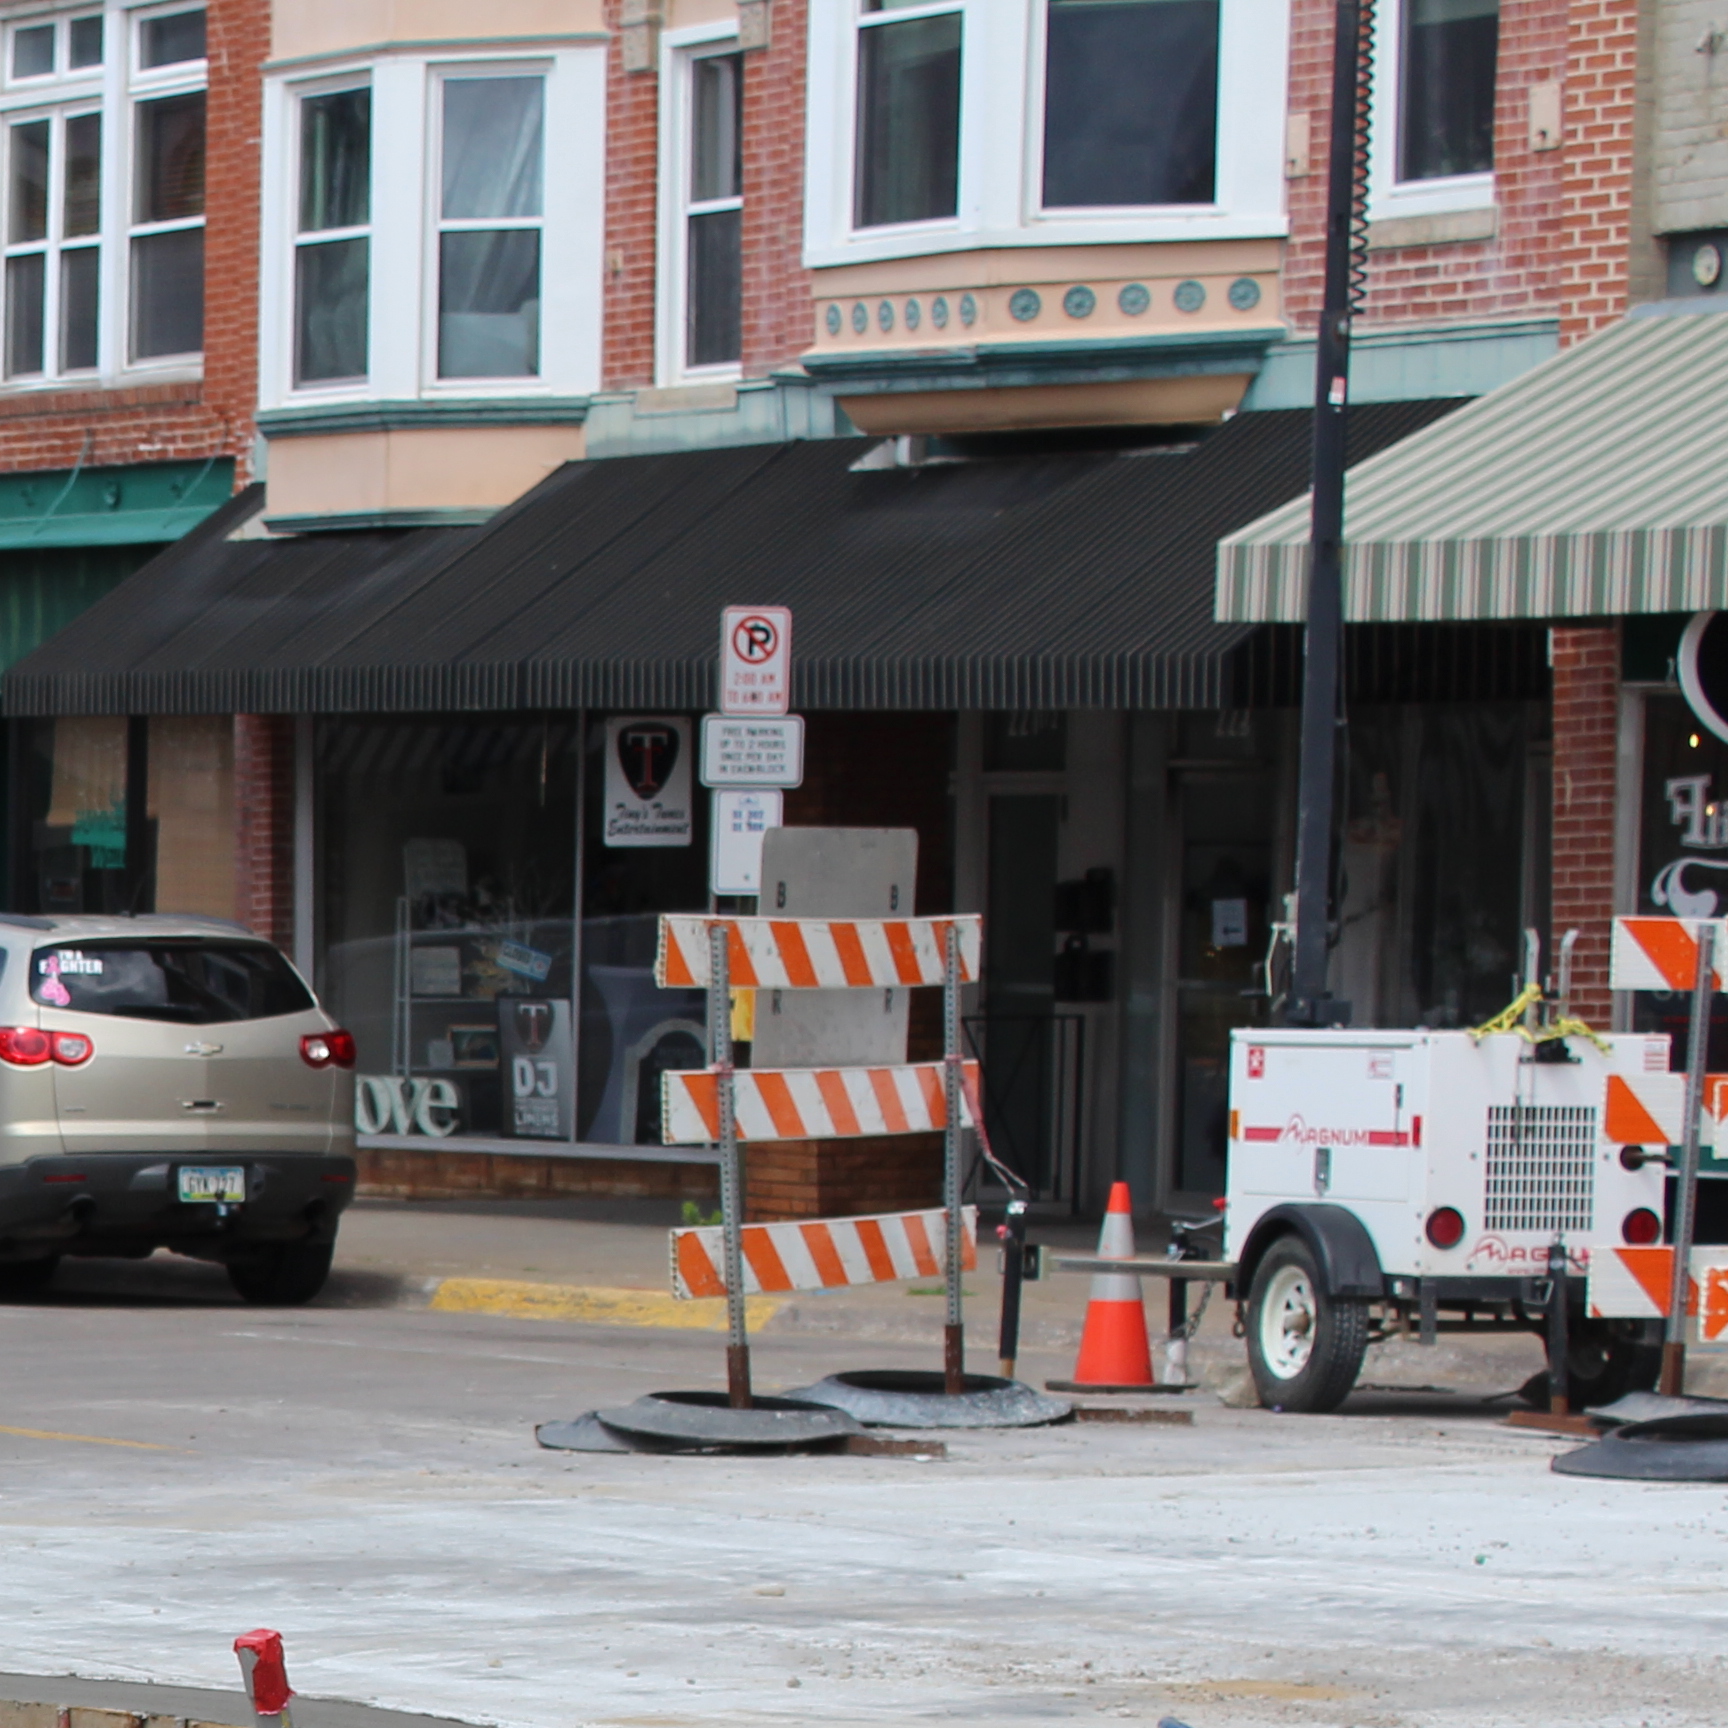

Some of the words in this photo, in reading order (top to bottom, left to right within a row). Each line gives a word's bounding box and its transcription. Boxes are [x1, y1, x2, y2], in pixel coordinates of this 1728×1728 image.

[761, 673, 776, 685] AM
[727, 690, 739, 703] TO
[769, 690, 783, 703] AM
[513, 1057, 559, 1098] DJ
